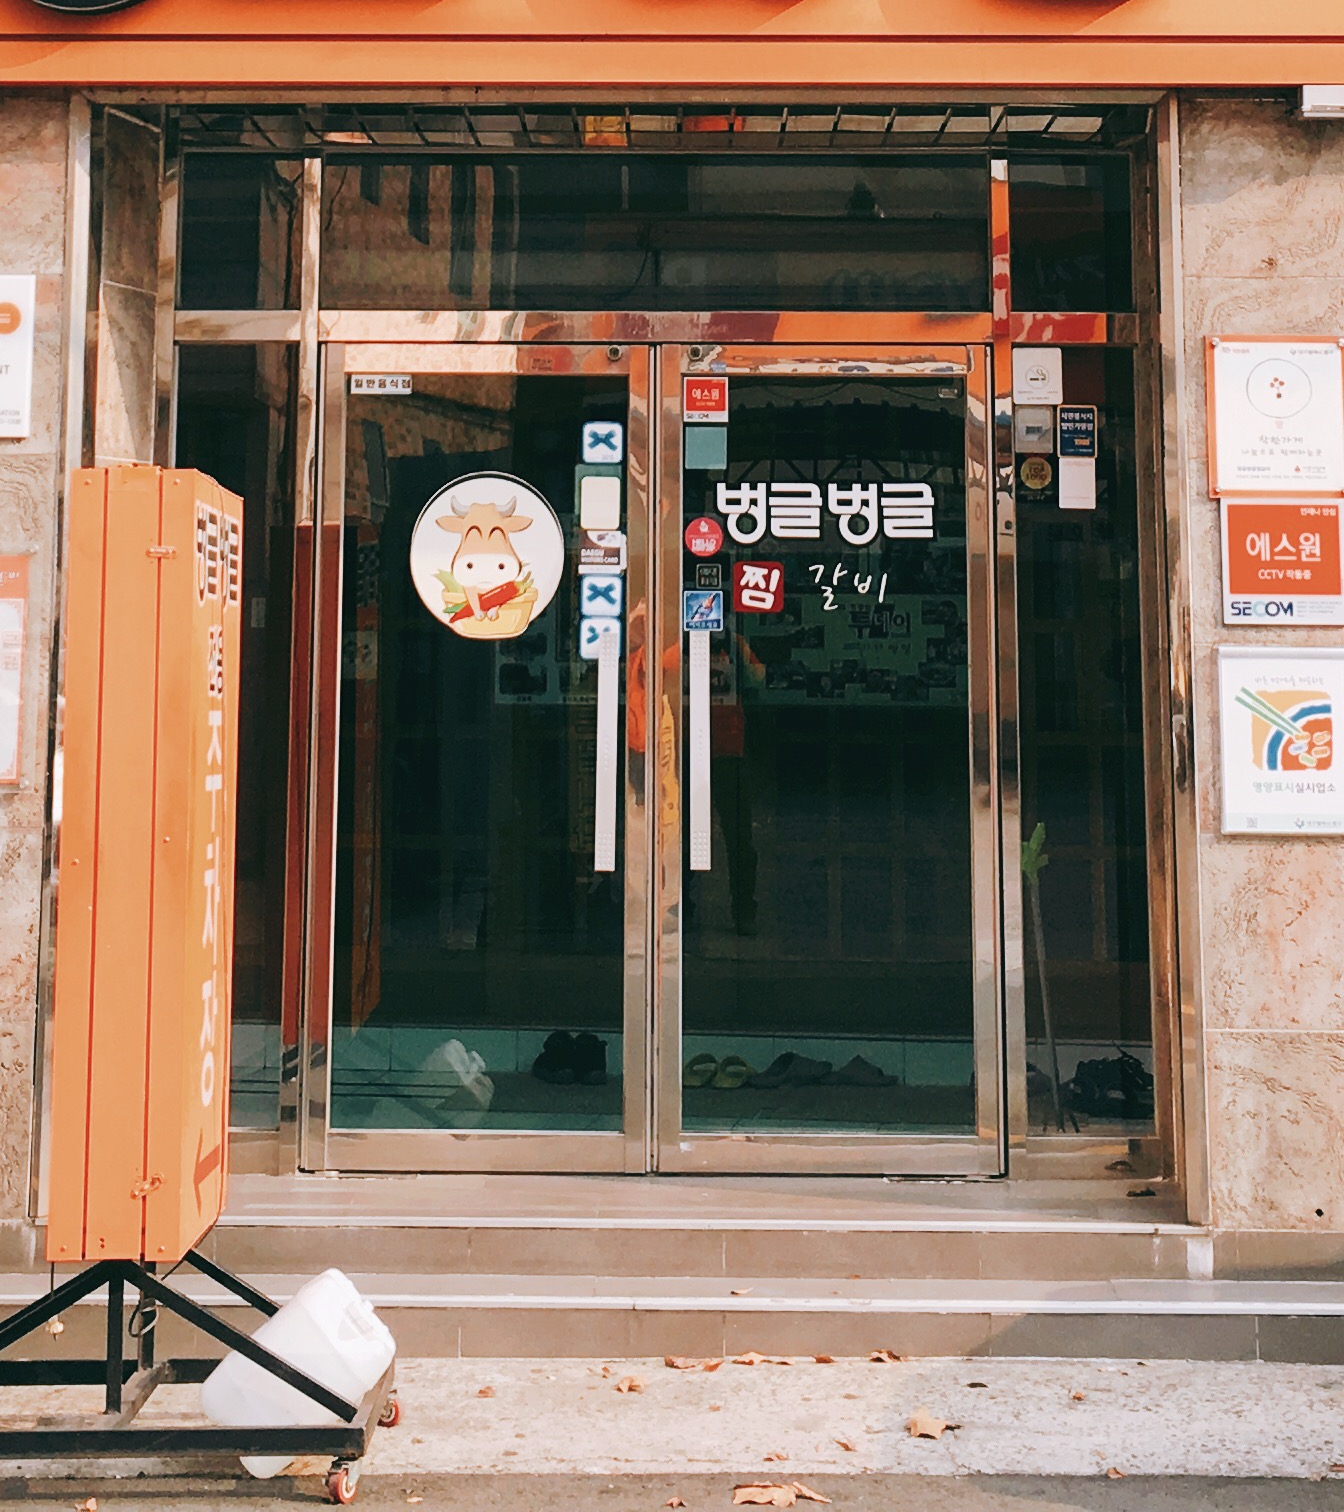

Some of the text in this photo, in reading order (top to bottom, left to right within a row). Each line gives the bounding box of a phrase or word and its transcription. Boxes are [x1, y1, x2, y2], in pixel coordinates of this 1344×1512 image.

[716, 482, 935, 545] 벙글벙글
[1245, 532, 1322, 562] 에스원
[737, 562, 888, 612] 찜 갈비
[1257, 568, 1285, 580] CCTV
[1230, 600, 1294, 617] SECOM
[200, 709, 223, 1108] 주차장
